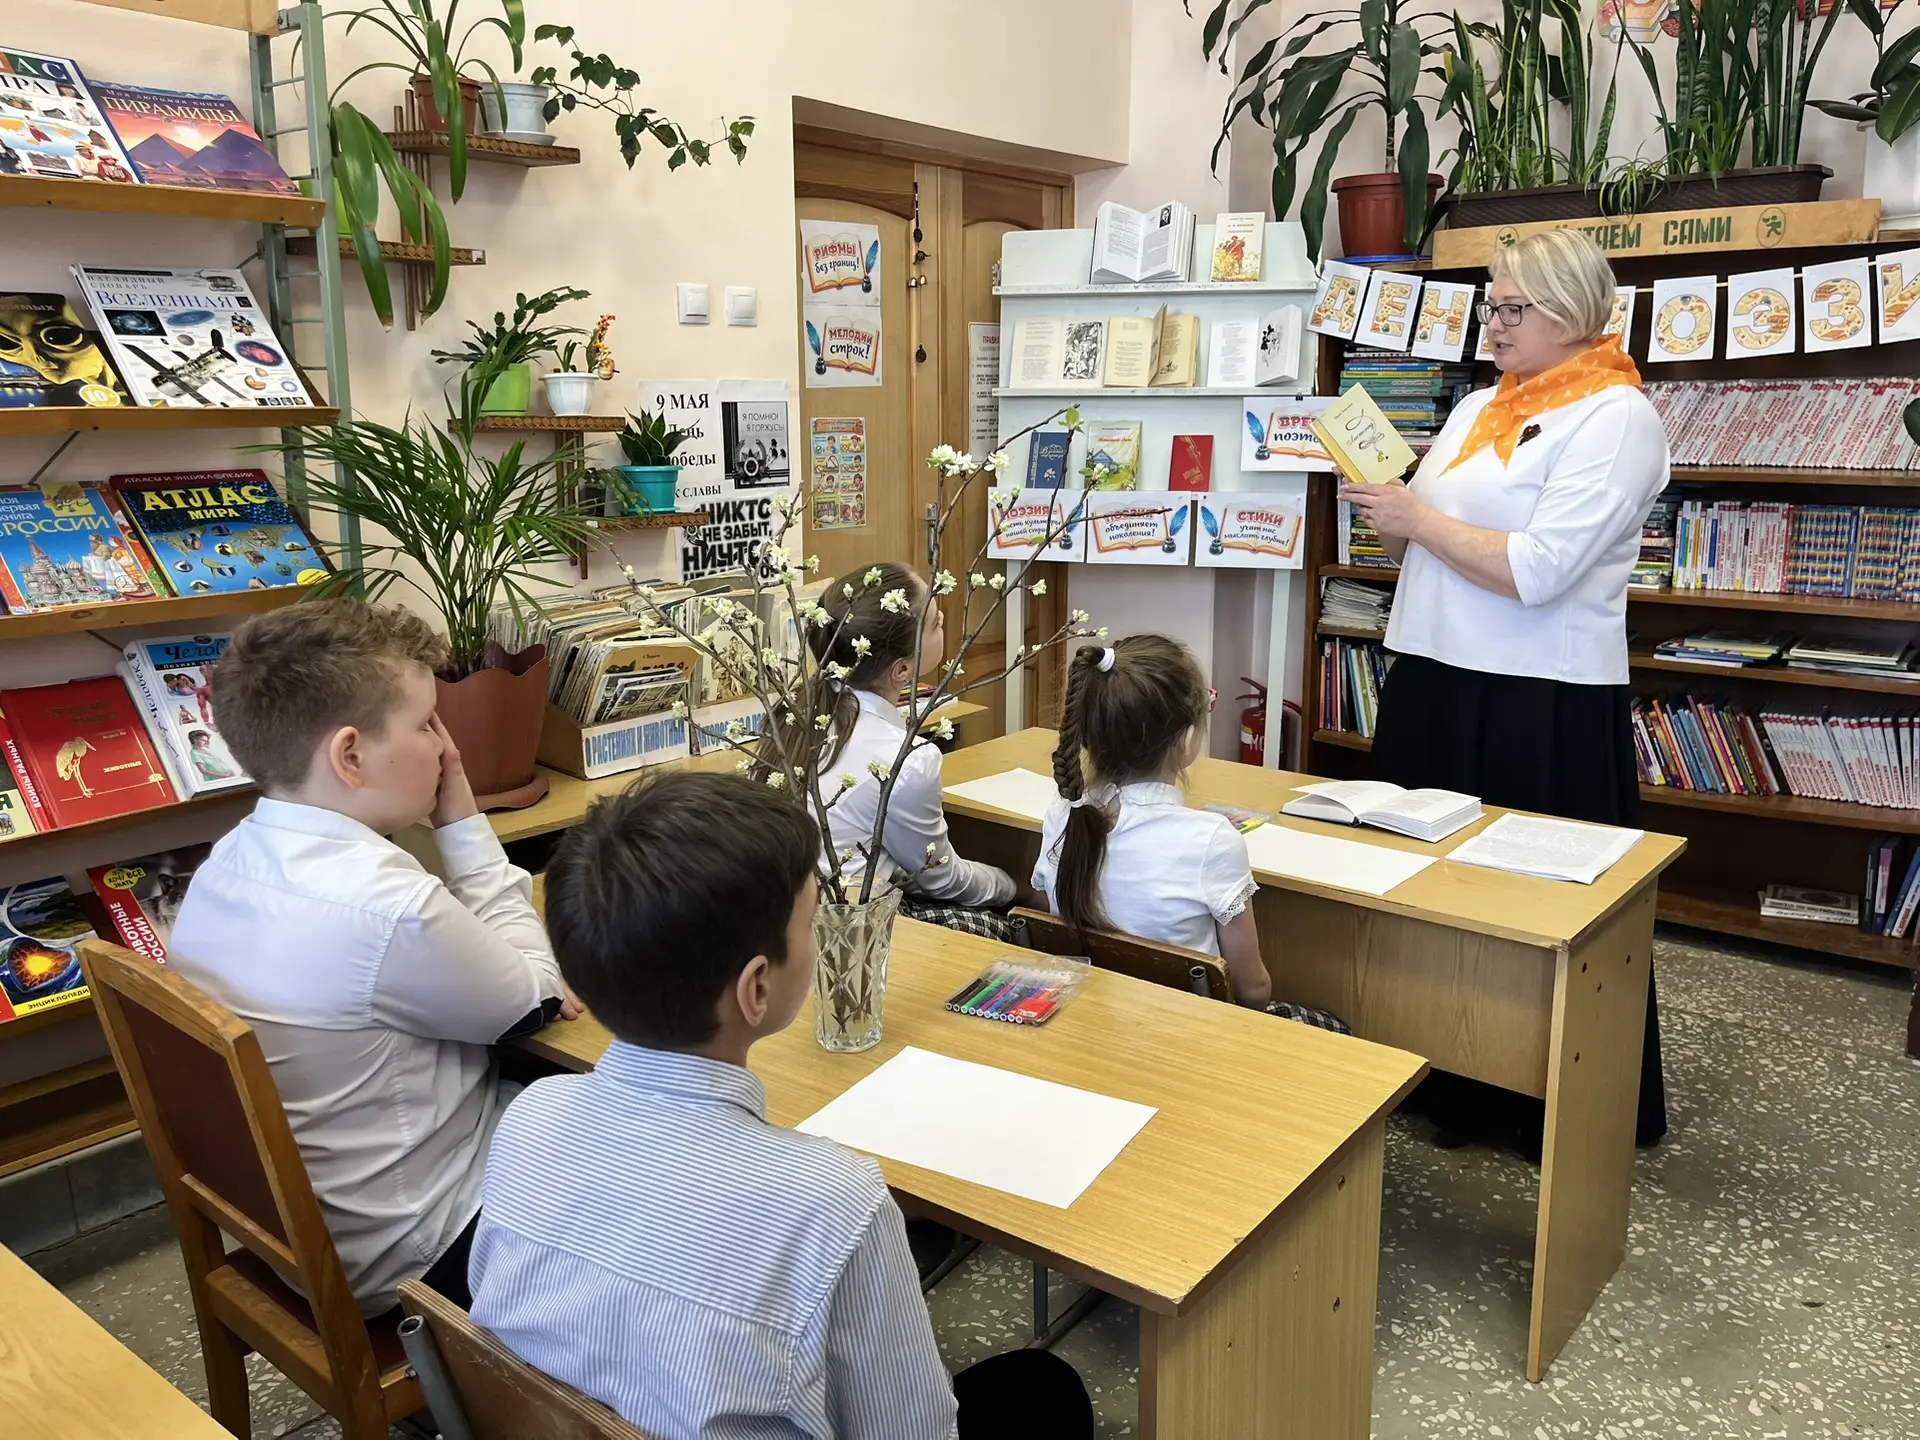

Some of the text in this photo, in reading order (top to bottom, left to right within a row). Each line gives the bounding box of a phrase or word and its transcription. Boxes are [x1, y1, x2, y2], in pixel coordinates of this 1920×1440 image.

[101, 96, 244, 122] ПИРАМИДЫ
[1555, 216, 1732, 250] ТАЕМ САМИ
[814, 243, 856, 260] РИФМЫ
[815, 257, 859, 274] без границ!
[90, 282, 148, 290] СЛОВАРЬ
[96, 290, 233, 309] ВСЕЛЕННАЯ
[1311, 274, 1493, 352] ДЕН
[829, 329, 873, 344] МЕЛОДИИ
[830, 344, 871, 359] строк!
[656, 393, 709, 410] 9 МАЯ
[742, 412, 748, 421] Я
[1279, 416, 1315, 429] ВРЕ
[746, 423, 751, 431] Я
[669, 451, 716, 467] обеды
[142, 485, 270, 511] АТЛАС
[682, 485, 721, 499] СЛАВЫ
[187, 508, 240, 520] МИРА
[1237, 511, 1285, 527] СТИХИ
[2, 516, 111, 536] РОССИИ
[702, 521, 772, 543] НЕ ЗАБЫТ,
[1025, 518, 1061, 530] культры
[1105, 521, 1158, 533] объединяет
[1109, 528, 1155, 540] поколения!
[165, 639, 227, 660] Челов
[584, 737, 592, 768] О
[636, 725, 643, 755] И
[5, 739, 27, 775] РАЗНЫХ
[126, 868, 144, 879] ВСЕ
[110, 902, 151, 958] ИВОТНЫЕ
[28, 989, 90, 1010] ЭНЦИКЛОПЕДИ
